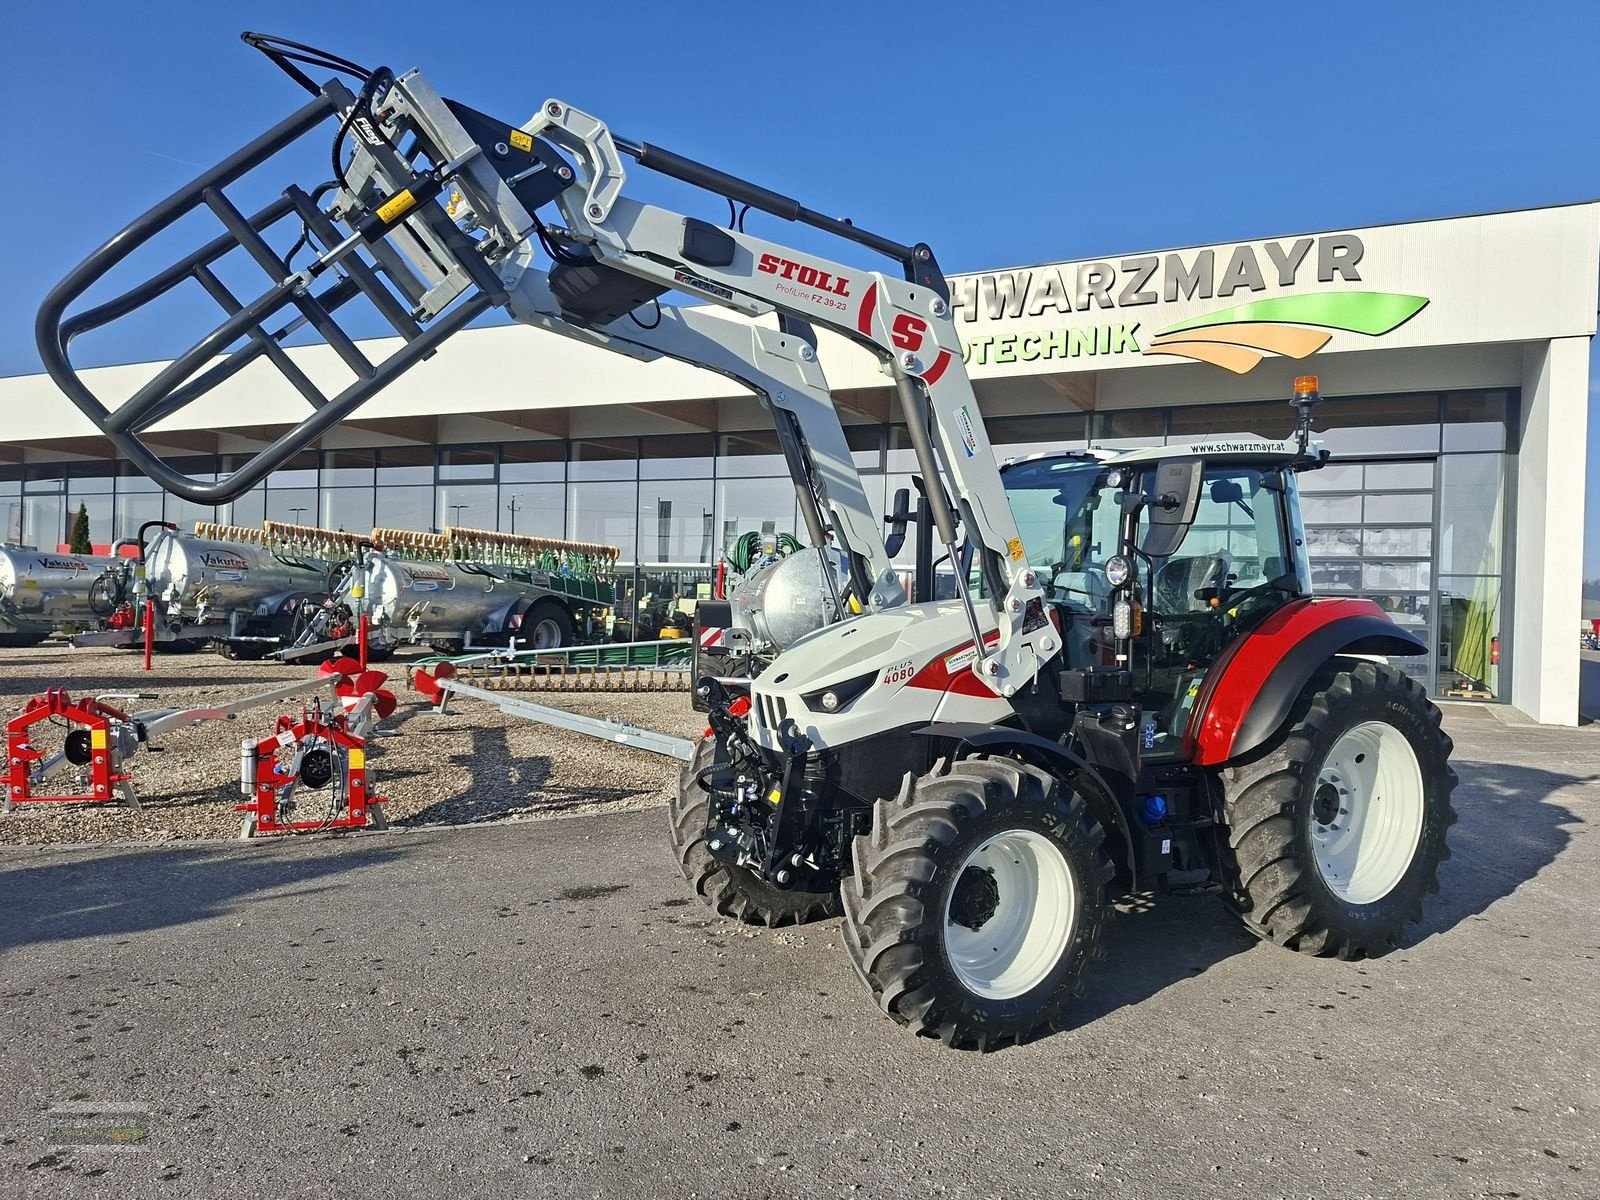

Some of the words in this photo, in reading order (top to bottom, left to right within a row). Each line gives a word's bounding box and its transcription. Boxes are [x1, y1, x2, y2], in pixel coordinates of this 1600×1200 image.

[353, 117, 385, 146] Fliegl
[758, 253, 850, 297] STOLL
[950, 234, 1364, 322] HWARZMAYR
[776, 283, 810, 300] ProfiLine
[811, 294, 823, 304] FZ
[824, 298, 847, 311] 39-23
[963, 321, 1141, 365] TECHNIK
[1190, 442, 1286, 454] www.schwarzmayr.at
[200, 553, 249, 569] Vakutec
[883, 666, 915, 685] 4080
[887, 659, 913, 673] PLUS
